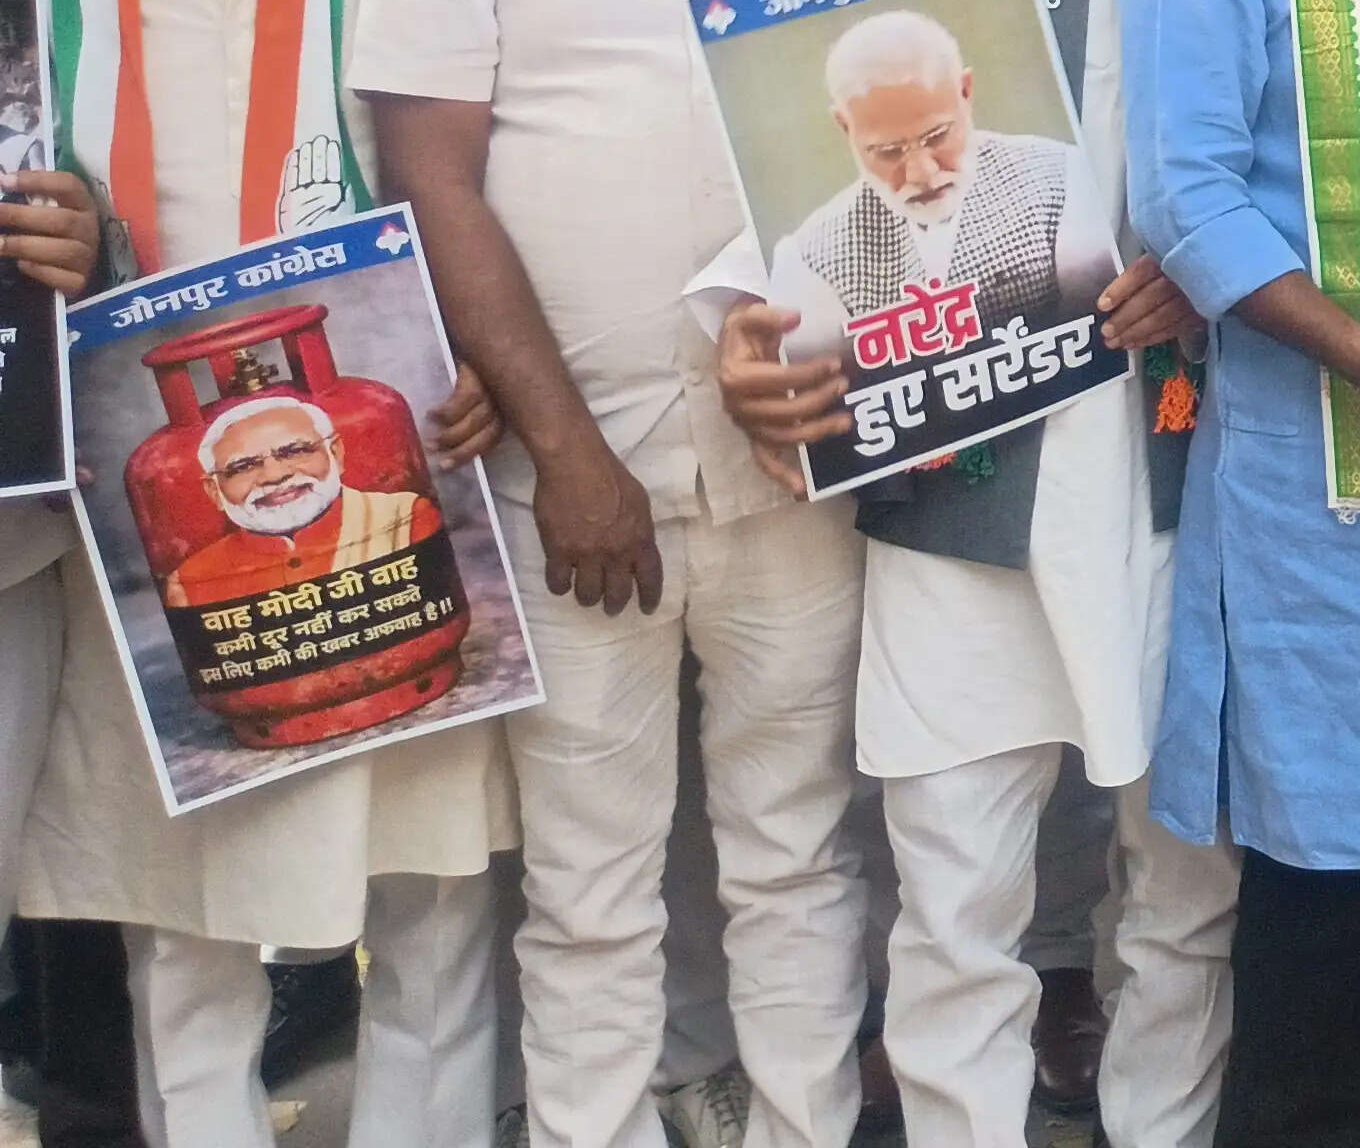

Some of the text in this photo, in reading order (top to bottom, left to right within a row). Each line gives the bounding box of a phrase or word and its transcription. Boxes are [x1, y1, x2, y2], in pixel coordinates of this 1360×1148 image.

[109, 242, 347, 328] जौनपुर कांग्रेस
[843, 277, 983, 369] नरेंद्र
[844, 369, 927, 457] हुए
[201, 554, 419, 632] वाह मोदी जी वाह
[213, 584, 422, 656] कमी दूर नहीं कर सकते
[222, 660, 254, 679] लिए
[255, 649, 292, 671] कमी
[294, 641, 318, 662] की
[319, 632, 360, 654] खबर
[363, 611, 423, 642] अफवाह
